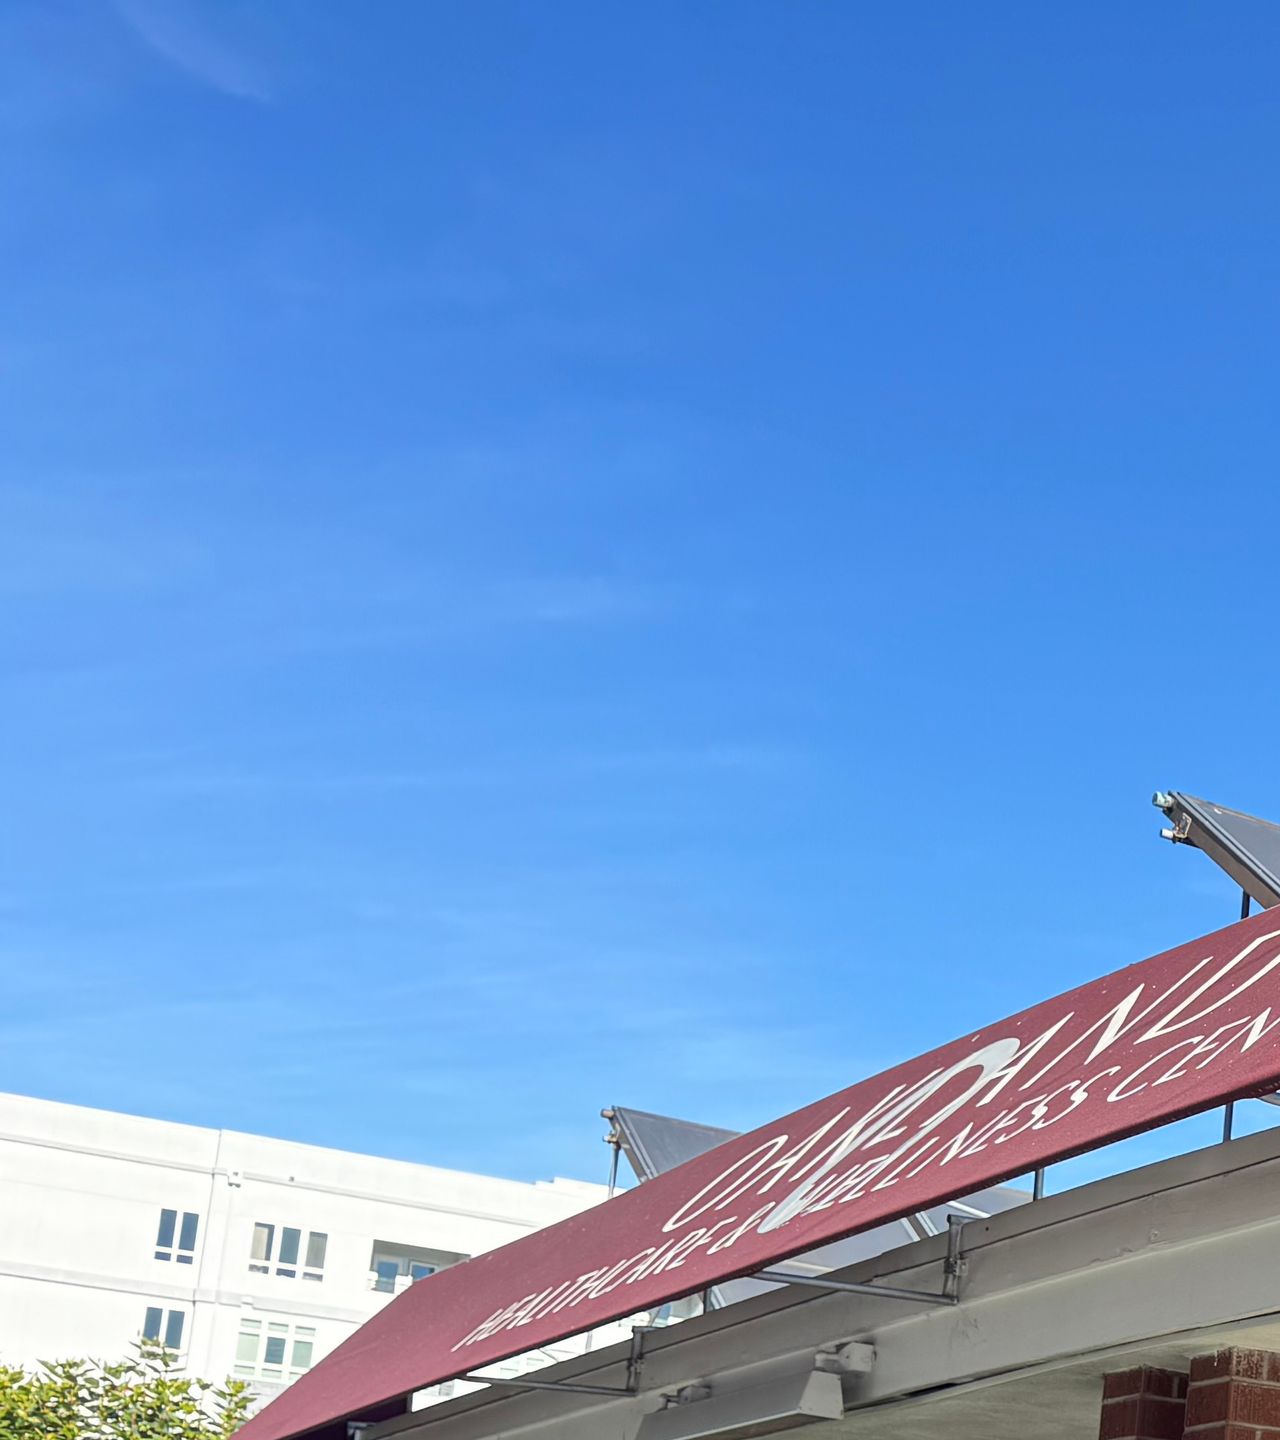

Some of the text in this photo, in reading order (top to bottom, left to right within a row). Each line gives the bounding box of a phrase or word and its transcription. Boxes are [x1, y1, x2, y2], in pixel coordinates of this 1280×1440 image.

[451, 1217, 738, 1352] HEALTHCARE
[707, 1202, 776, 1255] &
[780, 1065, 1122, 1226] WELLNESS
